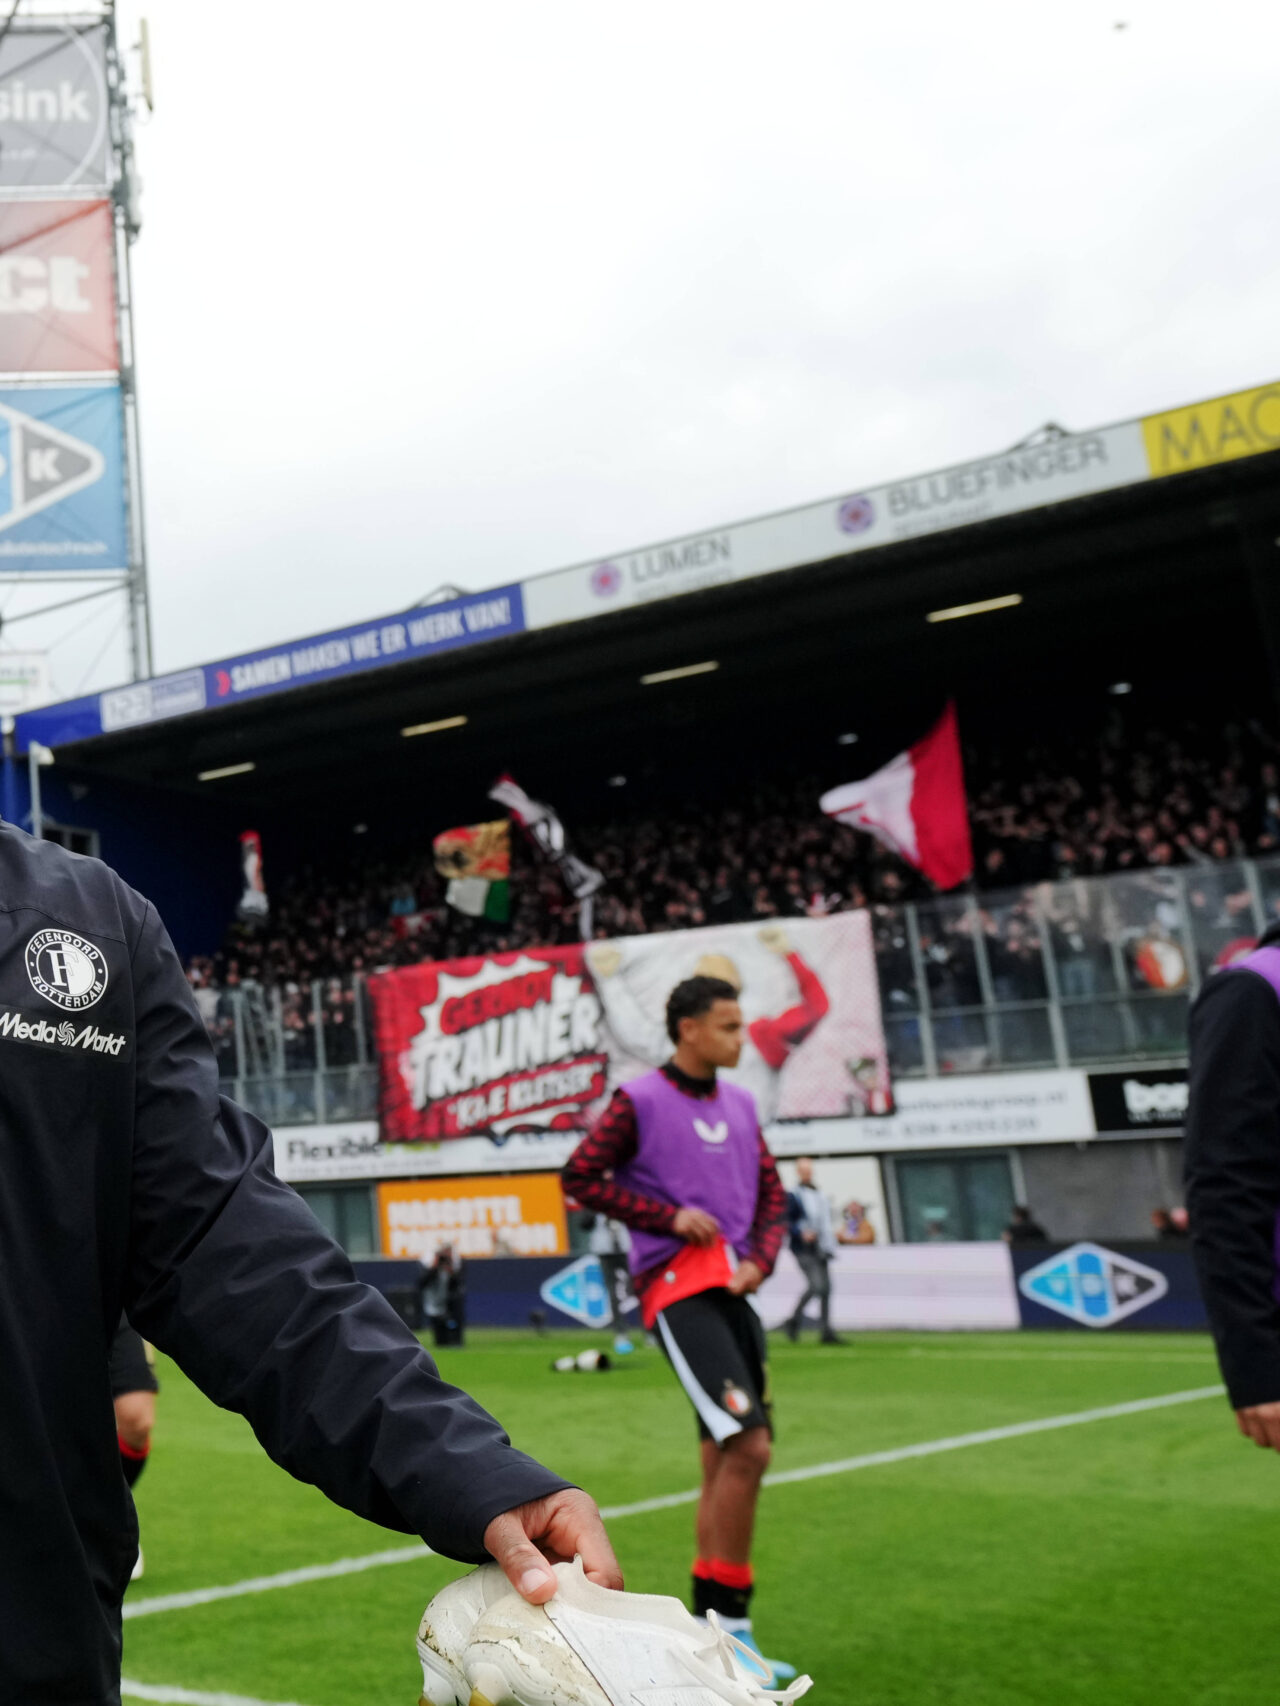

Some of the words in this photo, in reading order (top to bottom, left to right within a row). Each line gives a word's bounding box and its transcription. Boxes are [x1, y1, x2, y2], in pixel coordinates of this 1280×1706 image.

[888, 435, 1109, 517] BLUEFINGER
[630, 533, 733, 583] LUMEN
[350, 629, 381, 661] WE
[380, 622, 408, 654] ER
[30, 932, 99, 960] FEYENOORD
[33, 975, 104, 1008] ROTTERDAM
[70, 1025, 126, 1056] Markt
[409, 985, 601, 1112] TRAUNER
